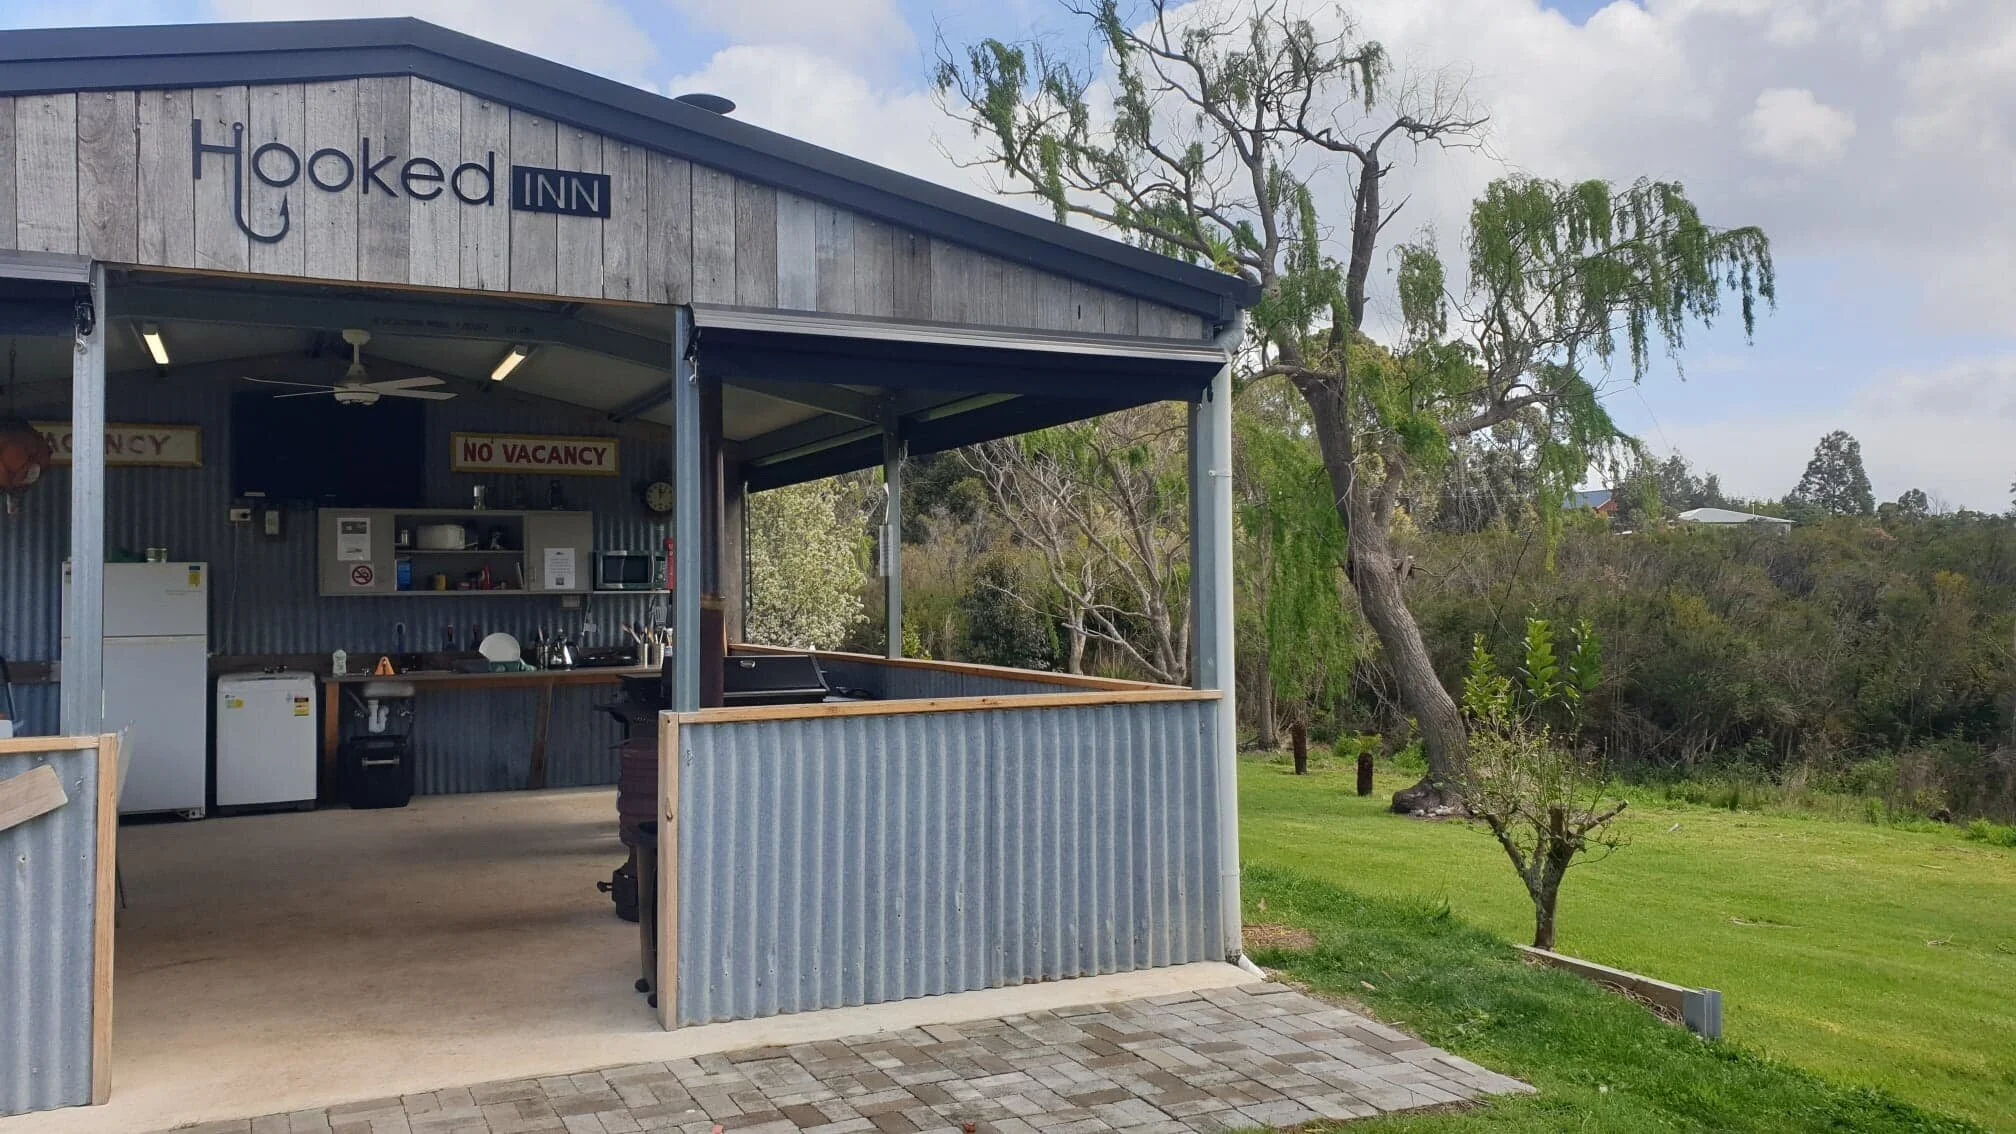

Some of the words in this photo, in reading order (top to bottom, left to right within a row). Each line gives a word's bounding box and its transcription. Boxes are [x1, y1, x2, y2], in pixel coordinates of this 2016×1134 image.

[192, 118, 495, 244] Hooked
[523, 171, 600, 213] INN
[36, 430, 171, 456] ACNCY
[463, 442, 493, 462] NO
[502, 444, 607, 466] VACANCY
